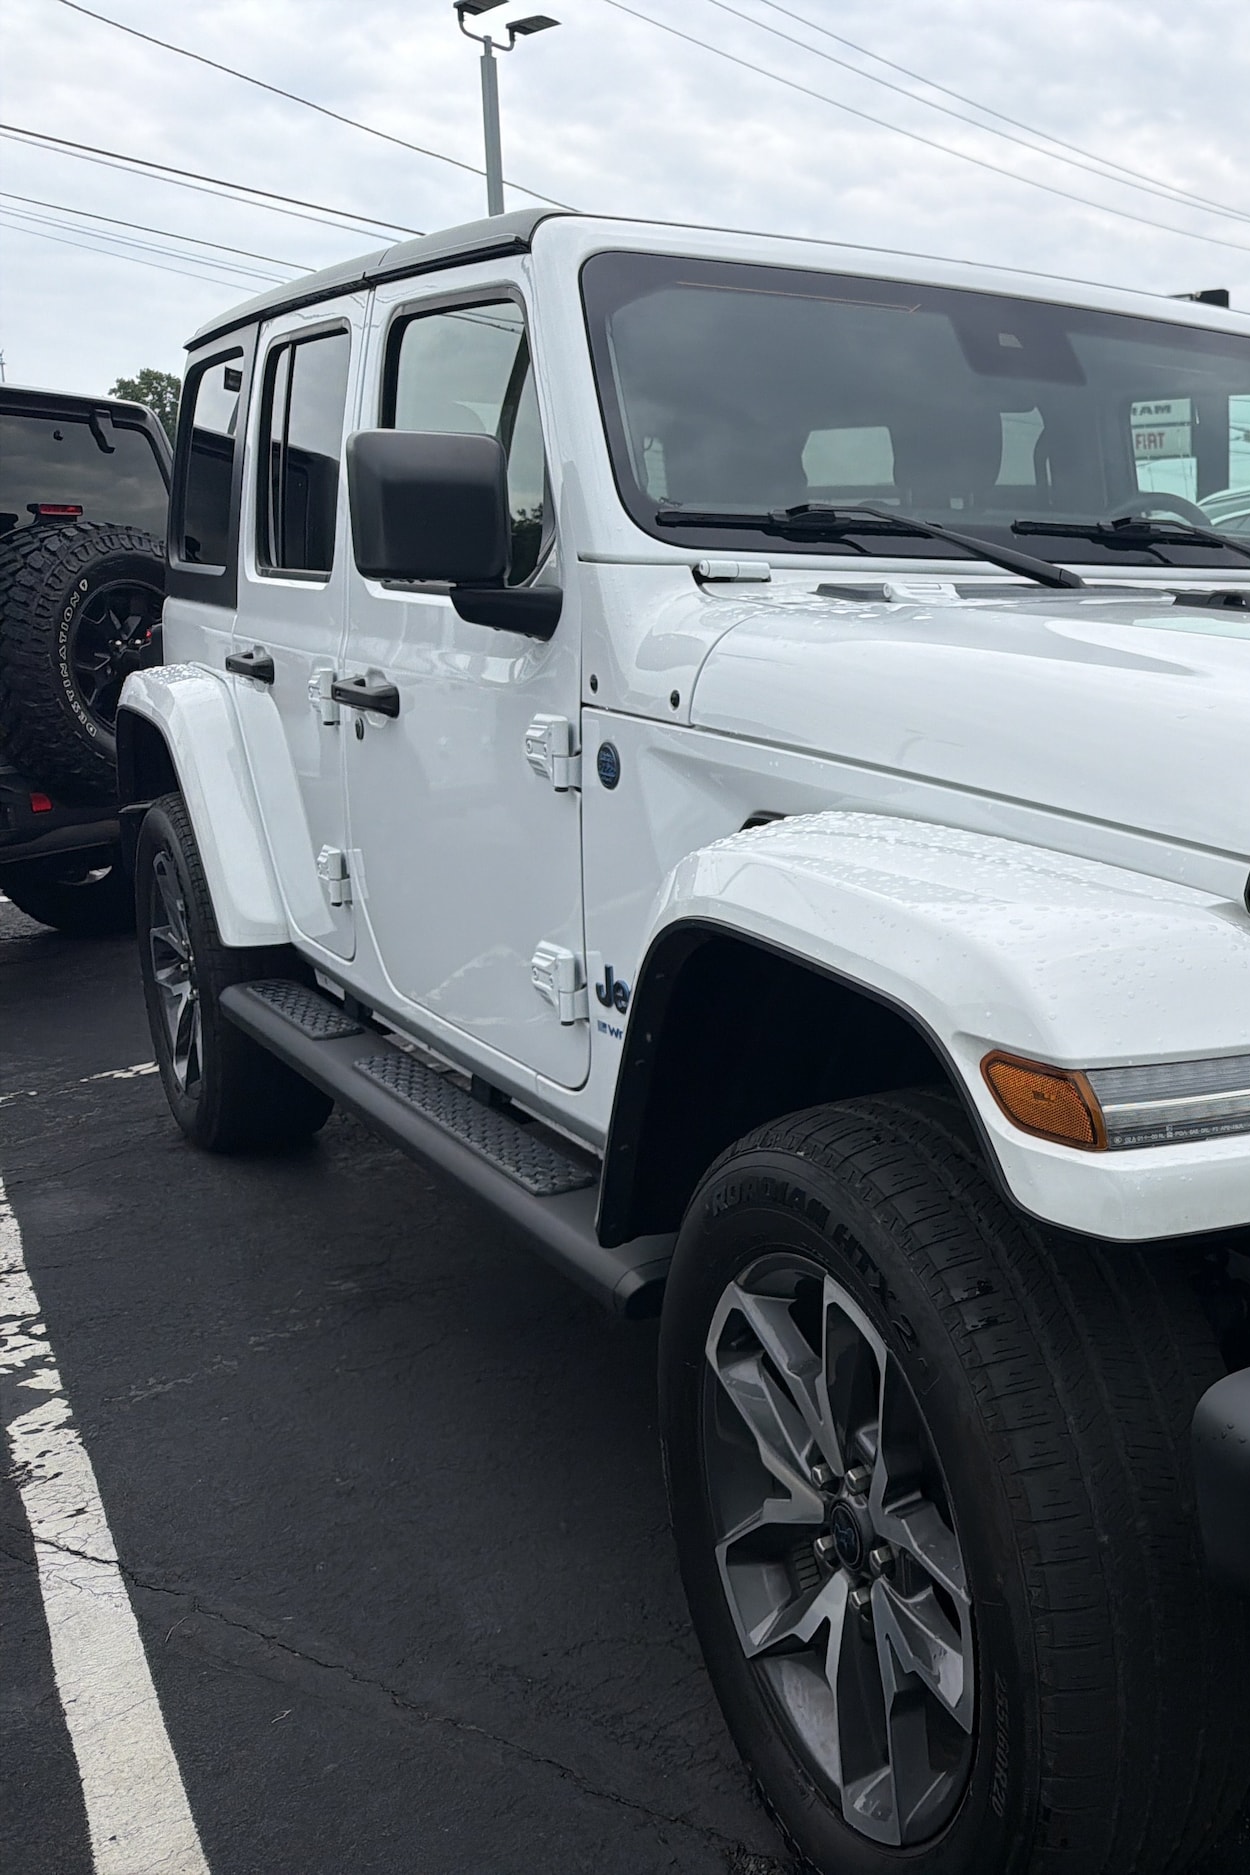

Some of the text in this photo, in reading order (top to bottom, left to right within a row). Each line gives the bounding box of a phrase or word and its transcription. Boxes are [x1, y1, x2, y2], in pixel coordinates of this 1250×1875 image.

[1135, 432, 1165, 450] FIAT
[59, 591, 97, 737] DESTINATION
[596, 964, 631, 1014] Je
